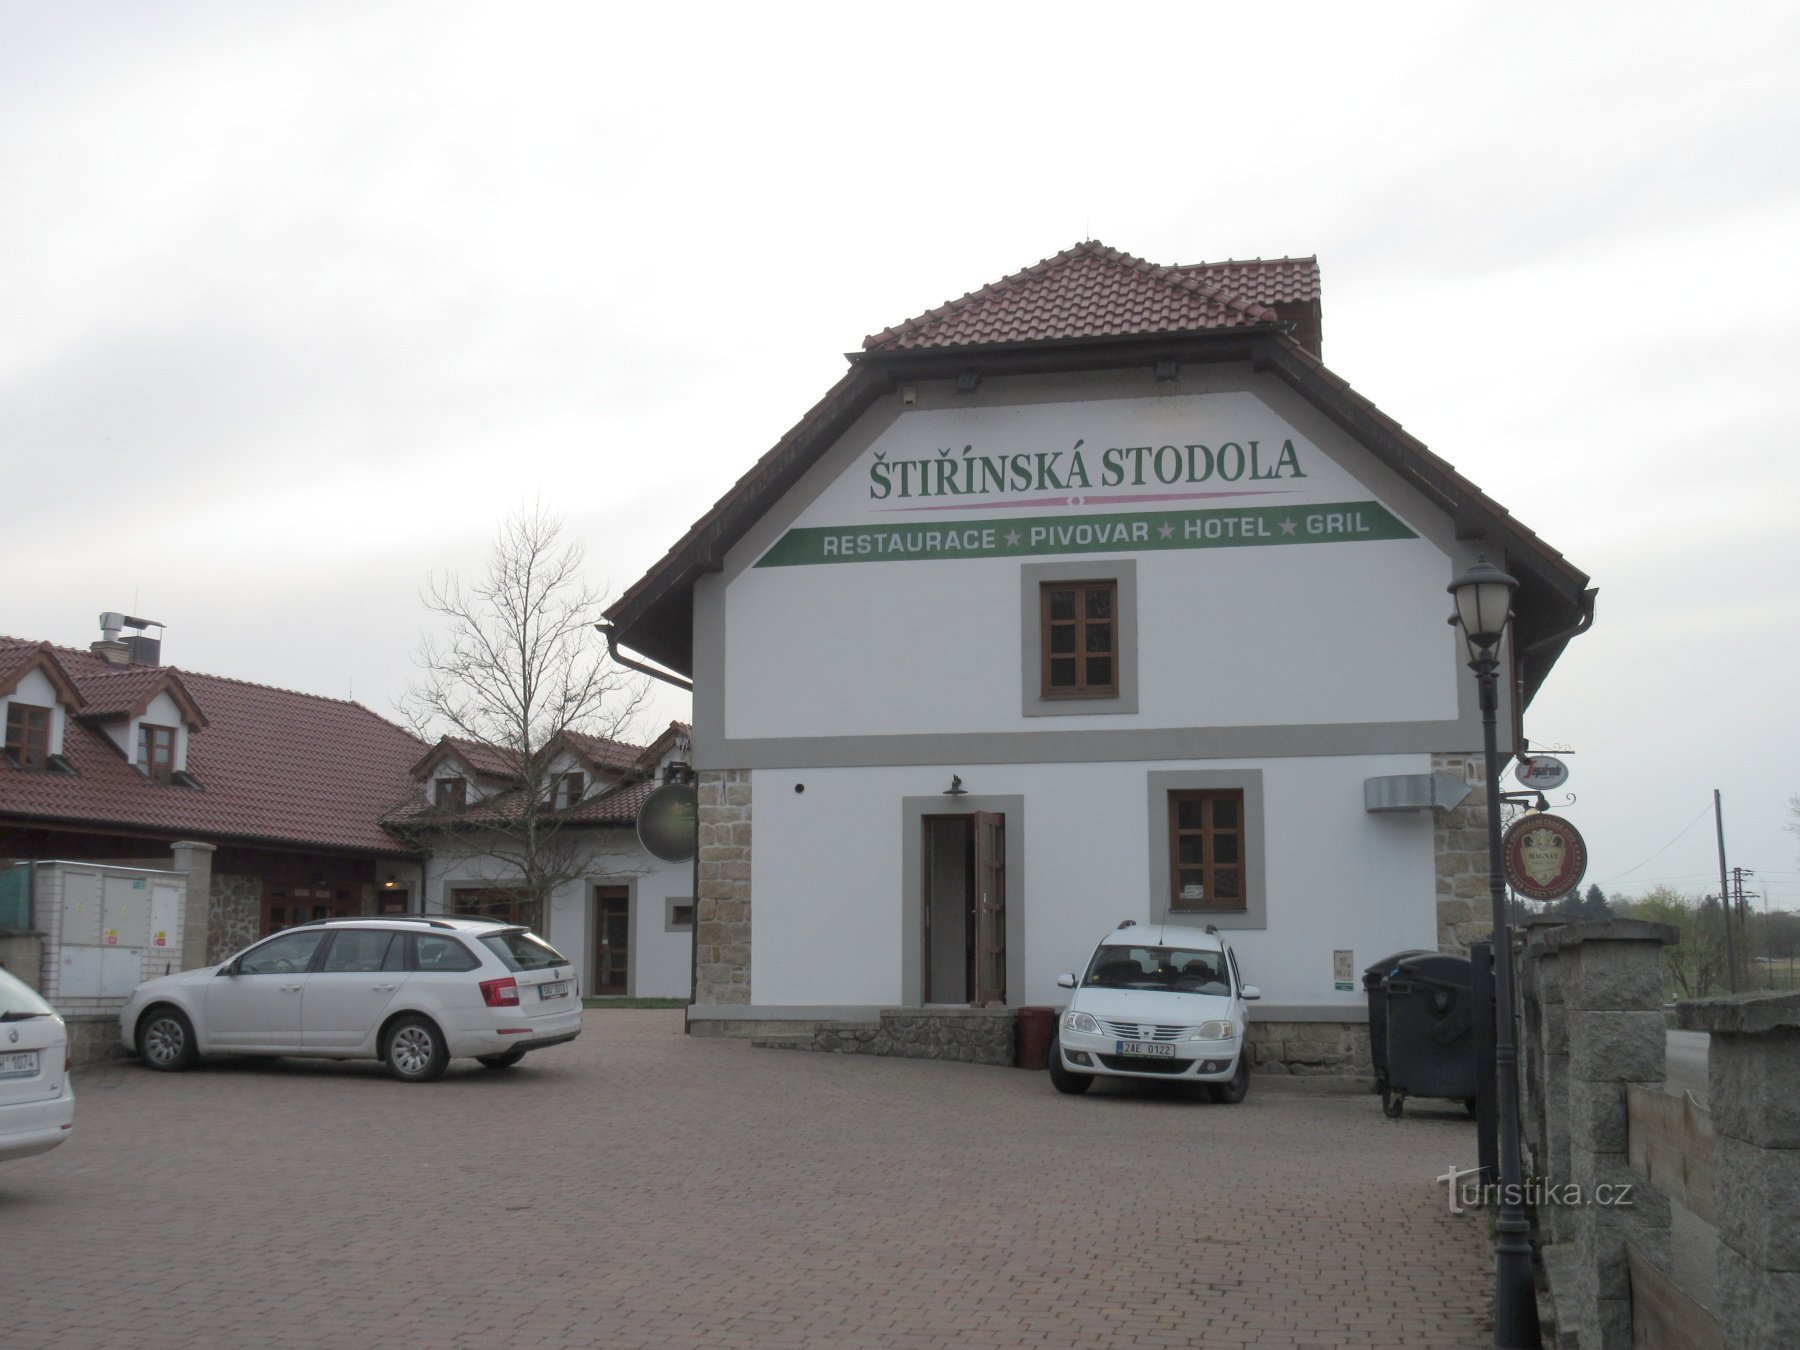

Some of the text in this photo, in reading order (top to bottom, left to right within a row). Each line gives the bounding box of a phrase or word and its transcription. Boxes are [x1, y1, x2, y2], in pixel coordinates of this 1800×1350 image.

[870, 439, 1308, 500] ŠTIŘÍNSKÁ STODOLA
[823, 512, 1370, 556] RESTAURACE PIVOVAR HOTEL GRIL
[12, 1054, 34, 1070] 1074
[1125, 1043, 1170, 1055] 2AE 0122
